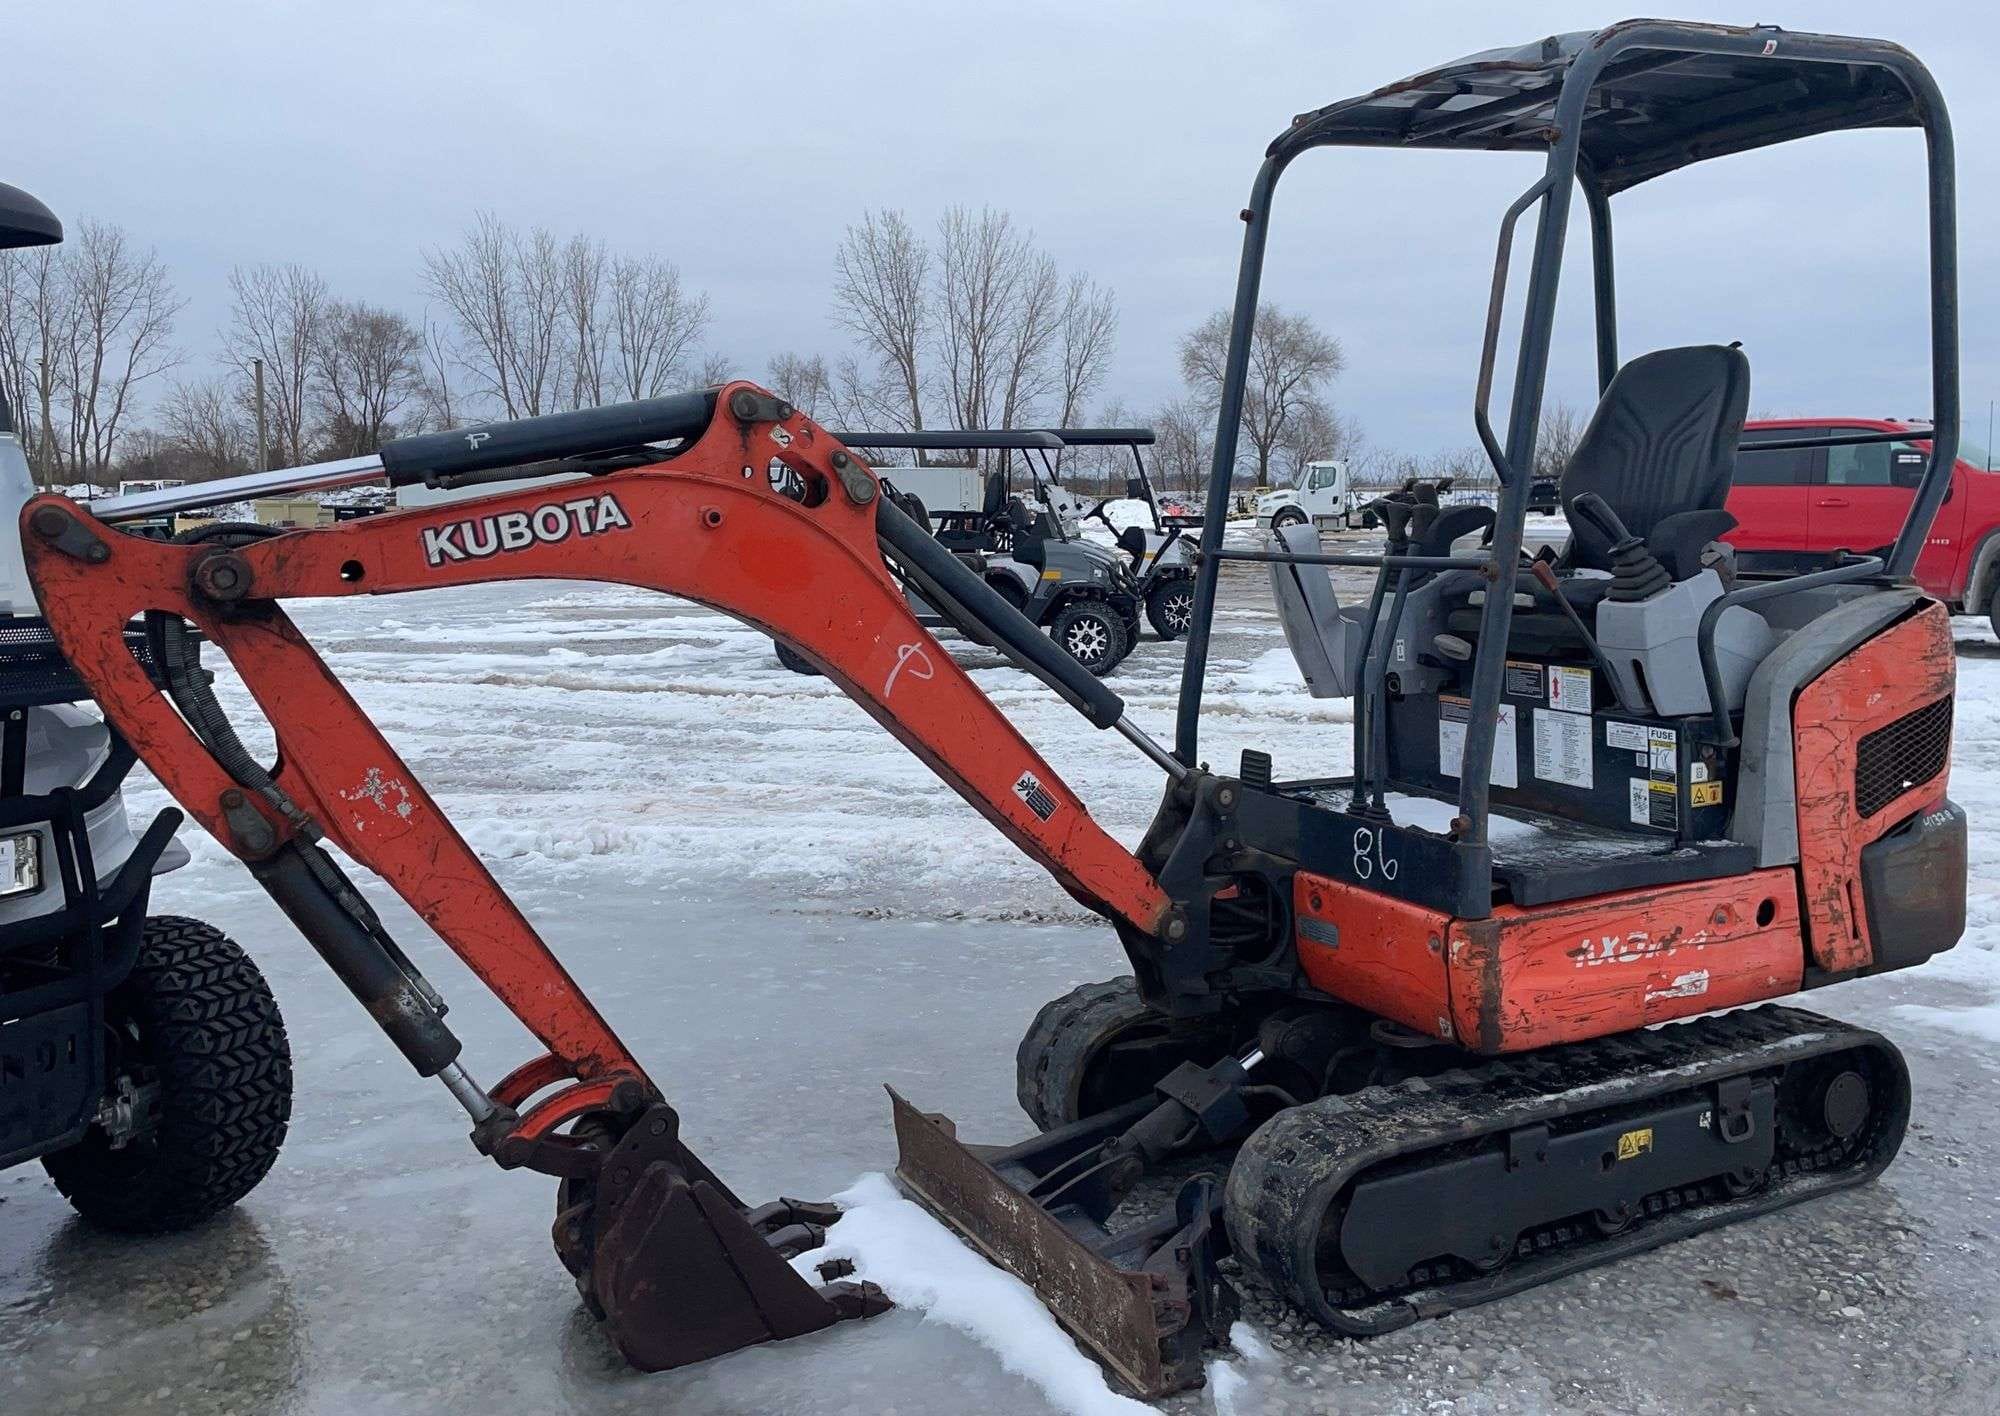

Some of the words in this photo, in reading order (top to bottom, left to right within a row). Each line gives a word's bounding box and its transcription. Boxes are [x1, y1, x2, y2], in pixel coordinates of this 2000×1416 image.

[422, 493, 630, 567] KUBOTA
[1650, 729, 1674, 741] FUSE
[1353, 827, 1398, 880] 86
